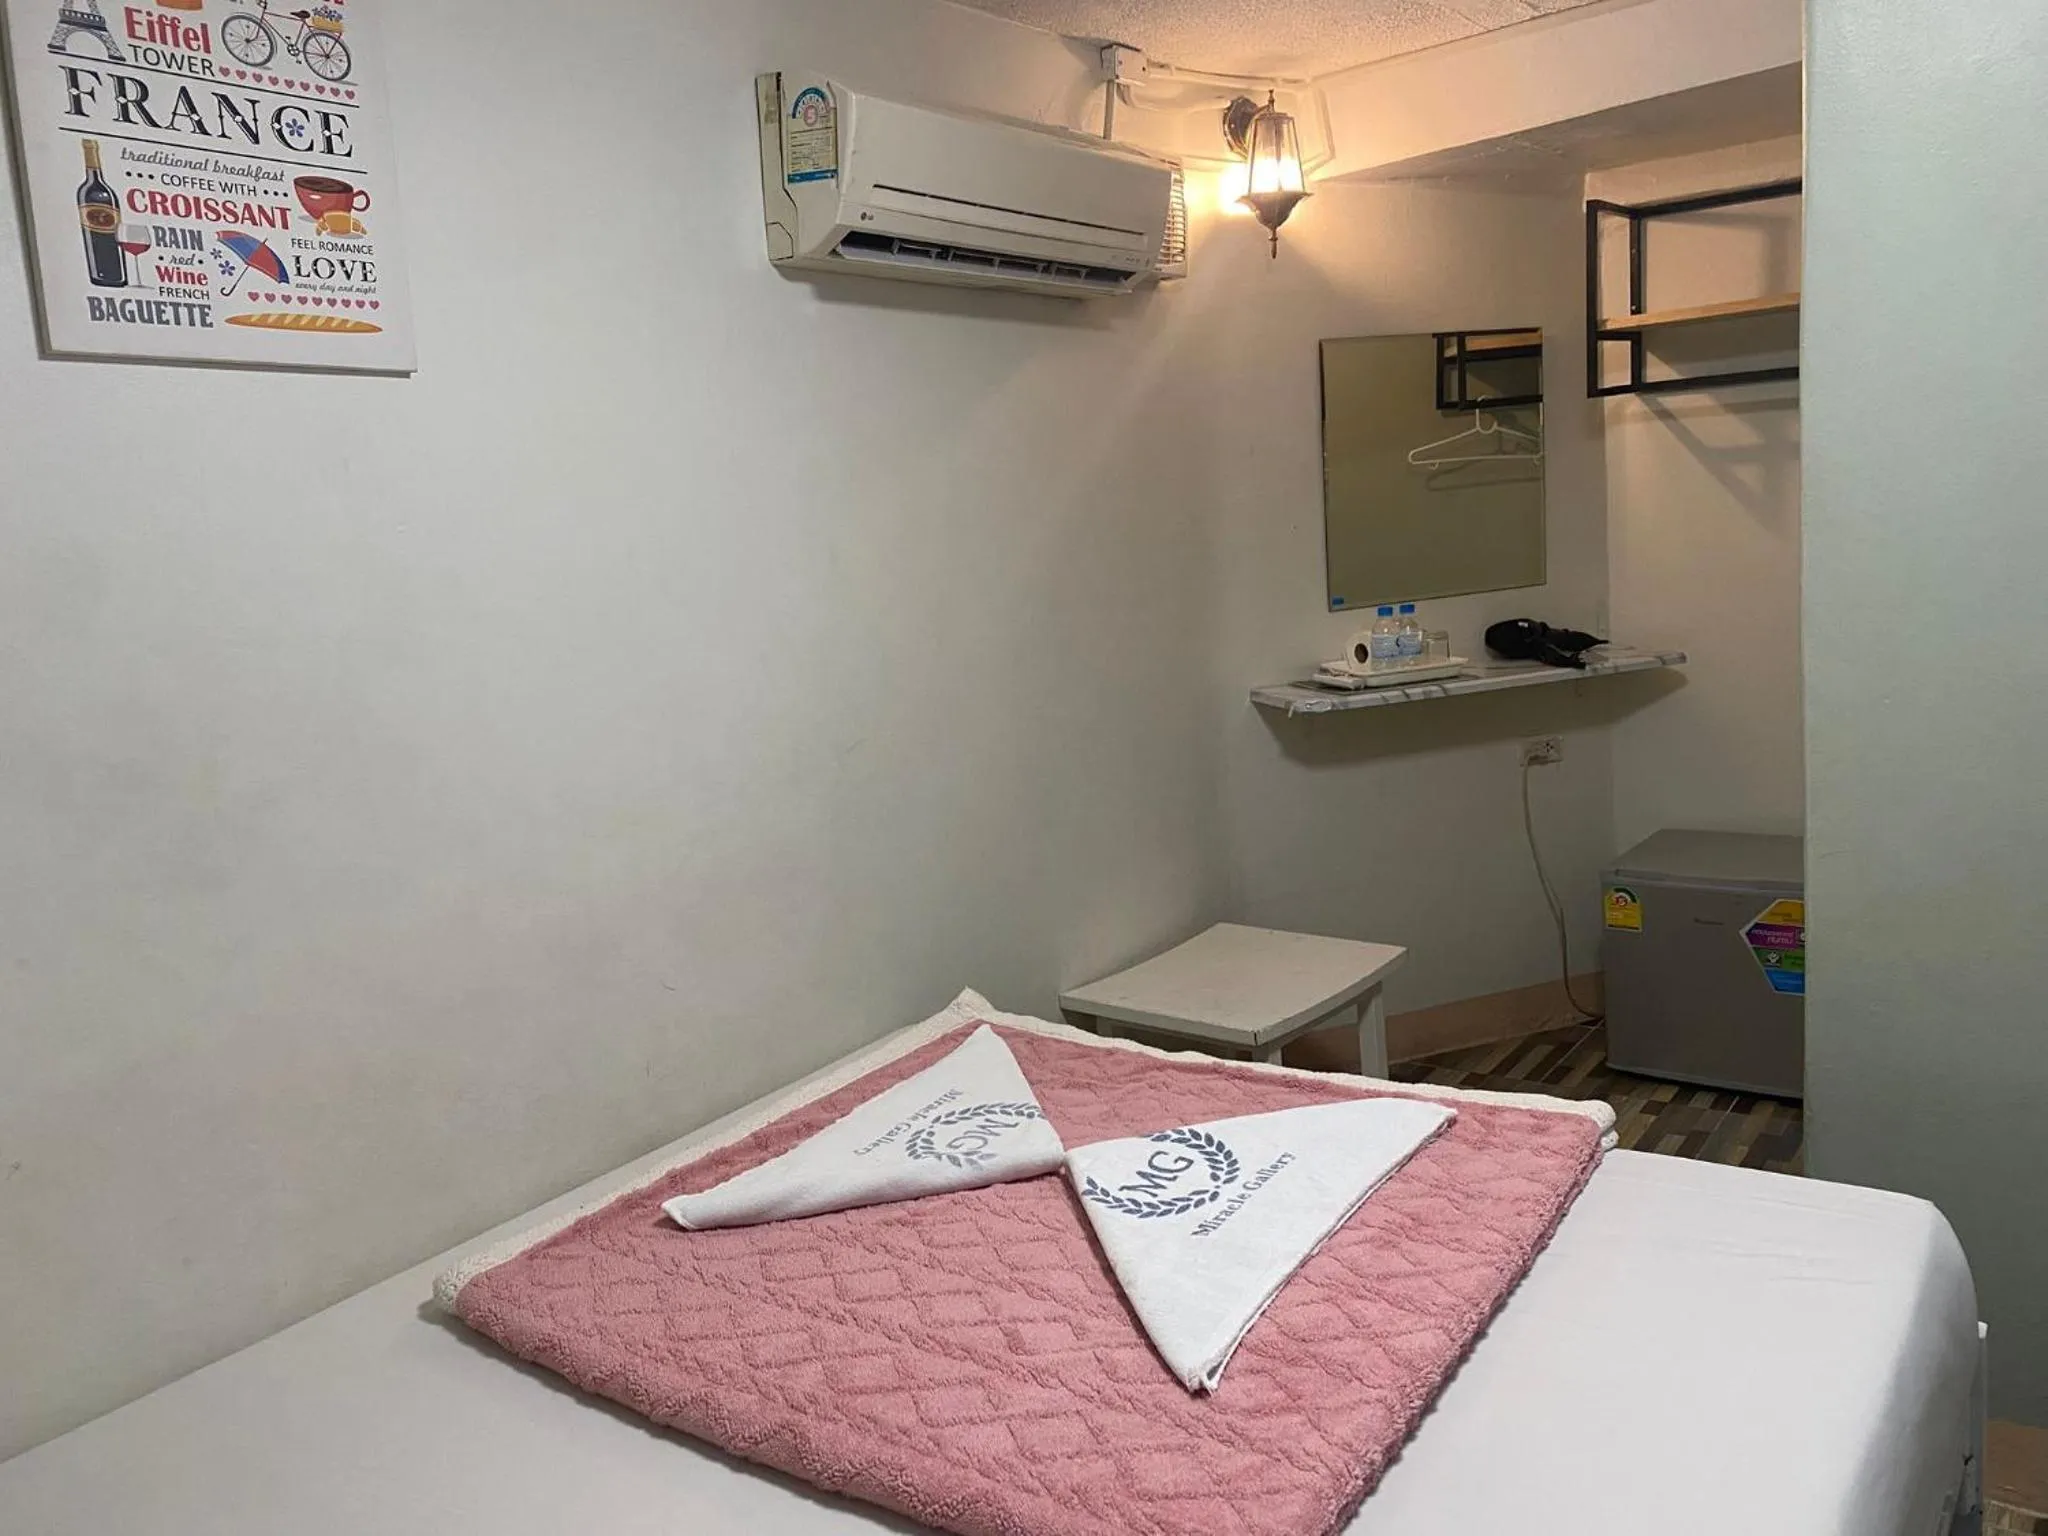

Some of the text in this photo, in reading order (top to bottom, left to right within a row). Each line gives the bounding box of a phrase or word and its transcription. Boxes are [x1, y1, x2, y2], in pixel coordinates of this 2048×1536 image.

[124, 7, 212, 54] Eiffel
[127, 43, 216, 77] TOWER
[59, 65, 353, 158] FRANCE
[120, 147, 285, 183] traditional breakfast
[160, 173, 258, 197] COFFEE WITH
[126, 188, 292, 231] CROISSANT
[152, 225, 204, 251] RAIN
[291, 238, 374, 255] FEEL ROMANCE
[155, 265, 209, 286] Wine
[169, 253, 196, 266] red
[291, 254, 378, 283] LOVE
[159, 286, 210, 300] FRENCH
[319, 282, 336, 293] day
[337, 284, 355, 292] and
[355, 285, 377, 295] night
[86, 296, 214, 328] BAGUETTE
[853, 1088, 964, 1156] Miracle Gallery
[945, 1117, 1020, 1151] MG
[1117, 1150, 1195, 1198] MG
[1190, 1151, 1298, 1237] Miracle Gallery
